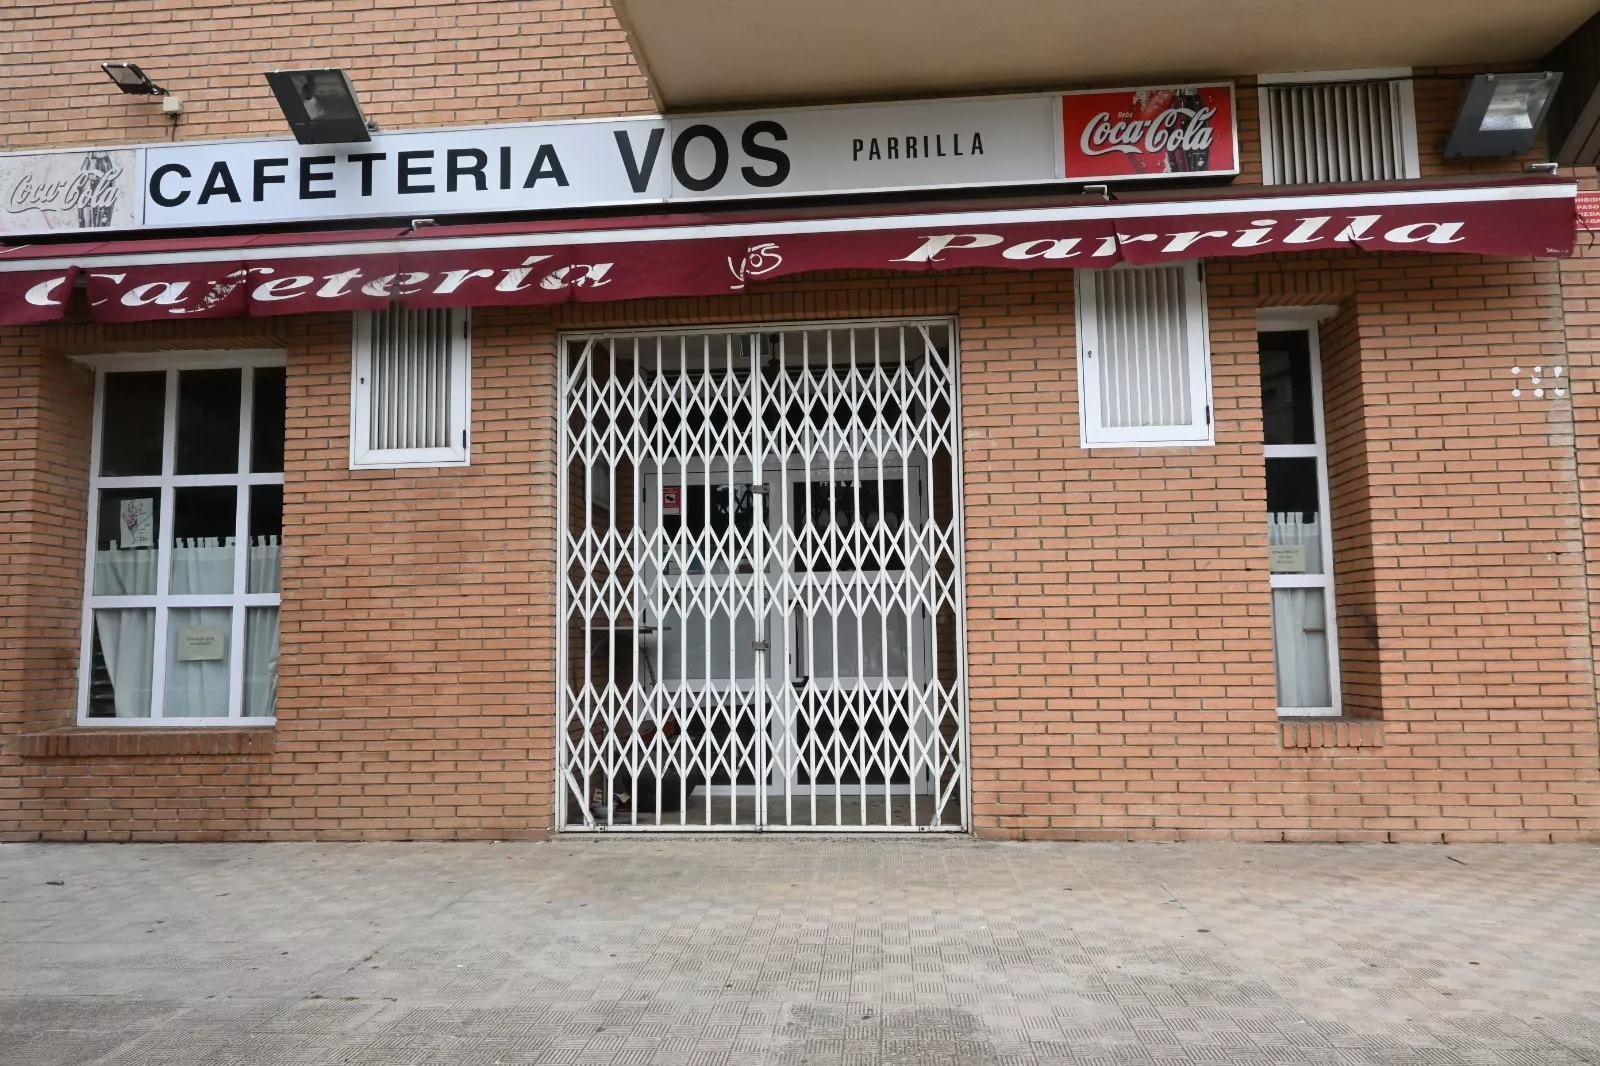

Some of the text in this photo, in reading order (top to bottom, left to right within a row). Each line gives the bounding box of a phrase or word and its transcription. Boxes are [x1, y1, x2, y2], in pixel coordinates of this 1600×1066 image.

[149, 120, 985, 207] CAFETERIA VOS PARRILLA
[1080, 106, 1217, 156] Coca-Cola
[6, 168, 123, 214] Coca-Cola
[25, 254, 615, 313] Cafeteria
[888, 214, 1466, 263] Parrilla
